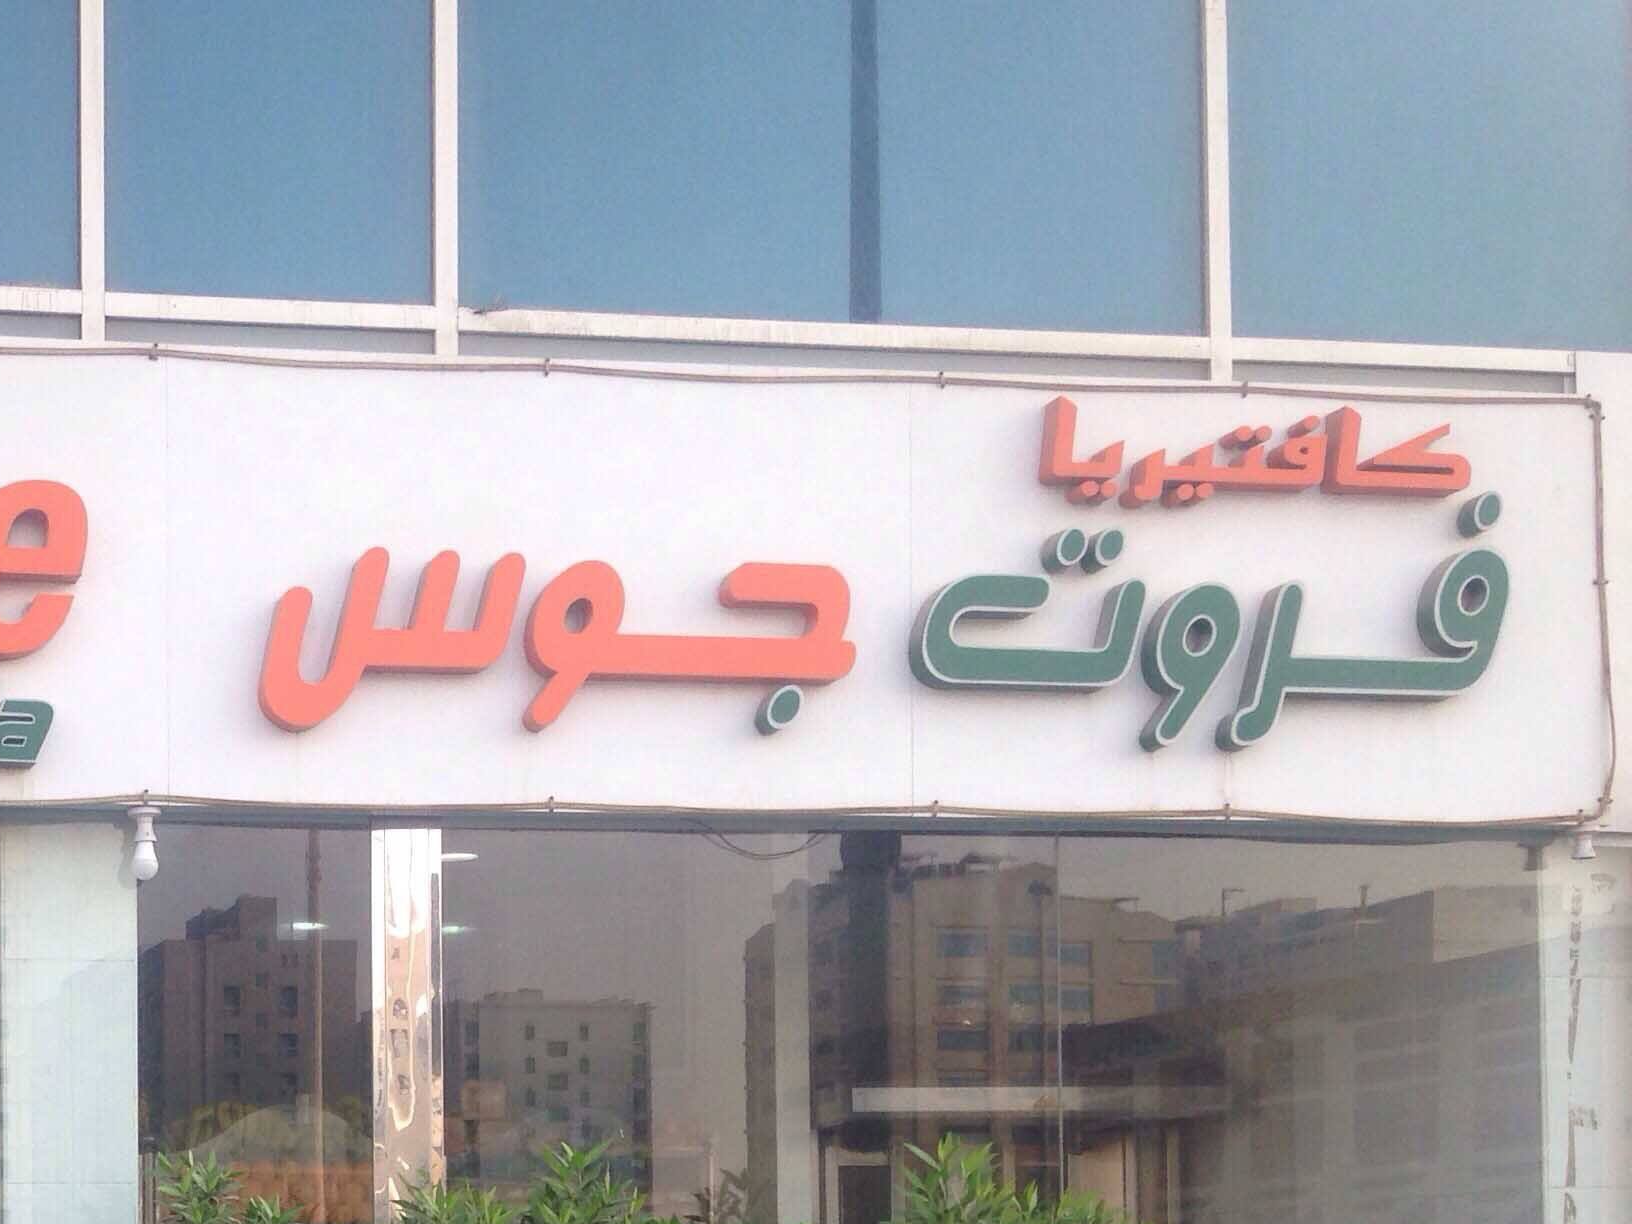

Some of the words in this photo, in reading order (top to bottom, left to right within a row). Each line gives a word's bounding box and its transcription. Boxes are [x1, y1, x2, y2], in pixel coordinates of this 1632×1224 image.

[1039, 395, 1471, 508] كافتيريا
[258, 546, 856, 736] جوس
[909, 490, 1509, 752] فروت
